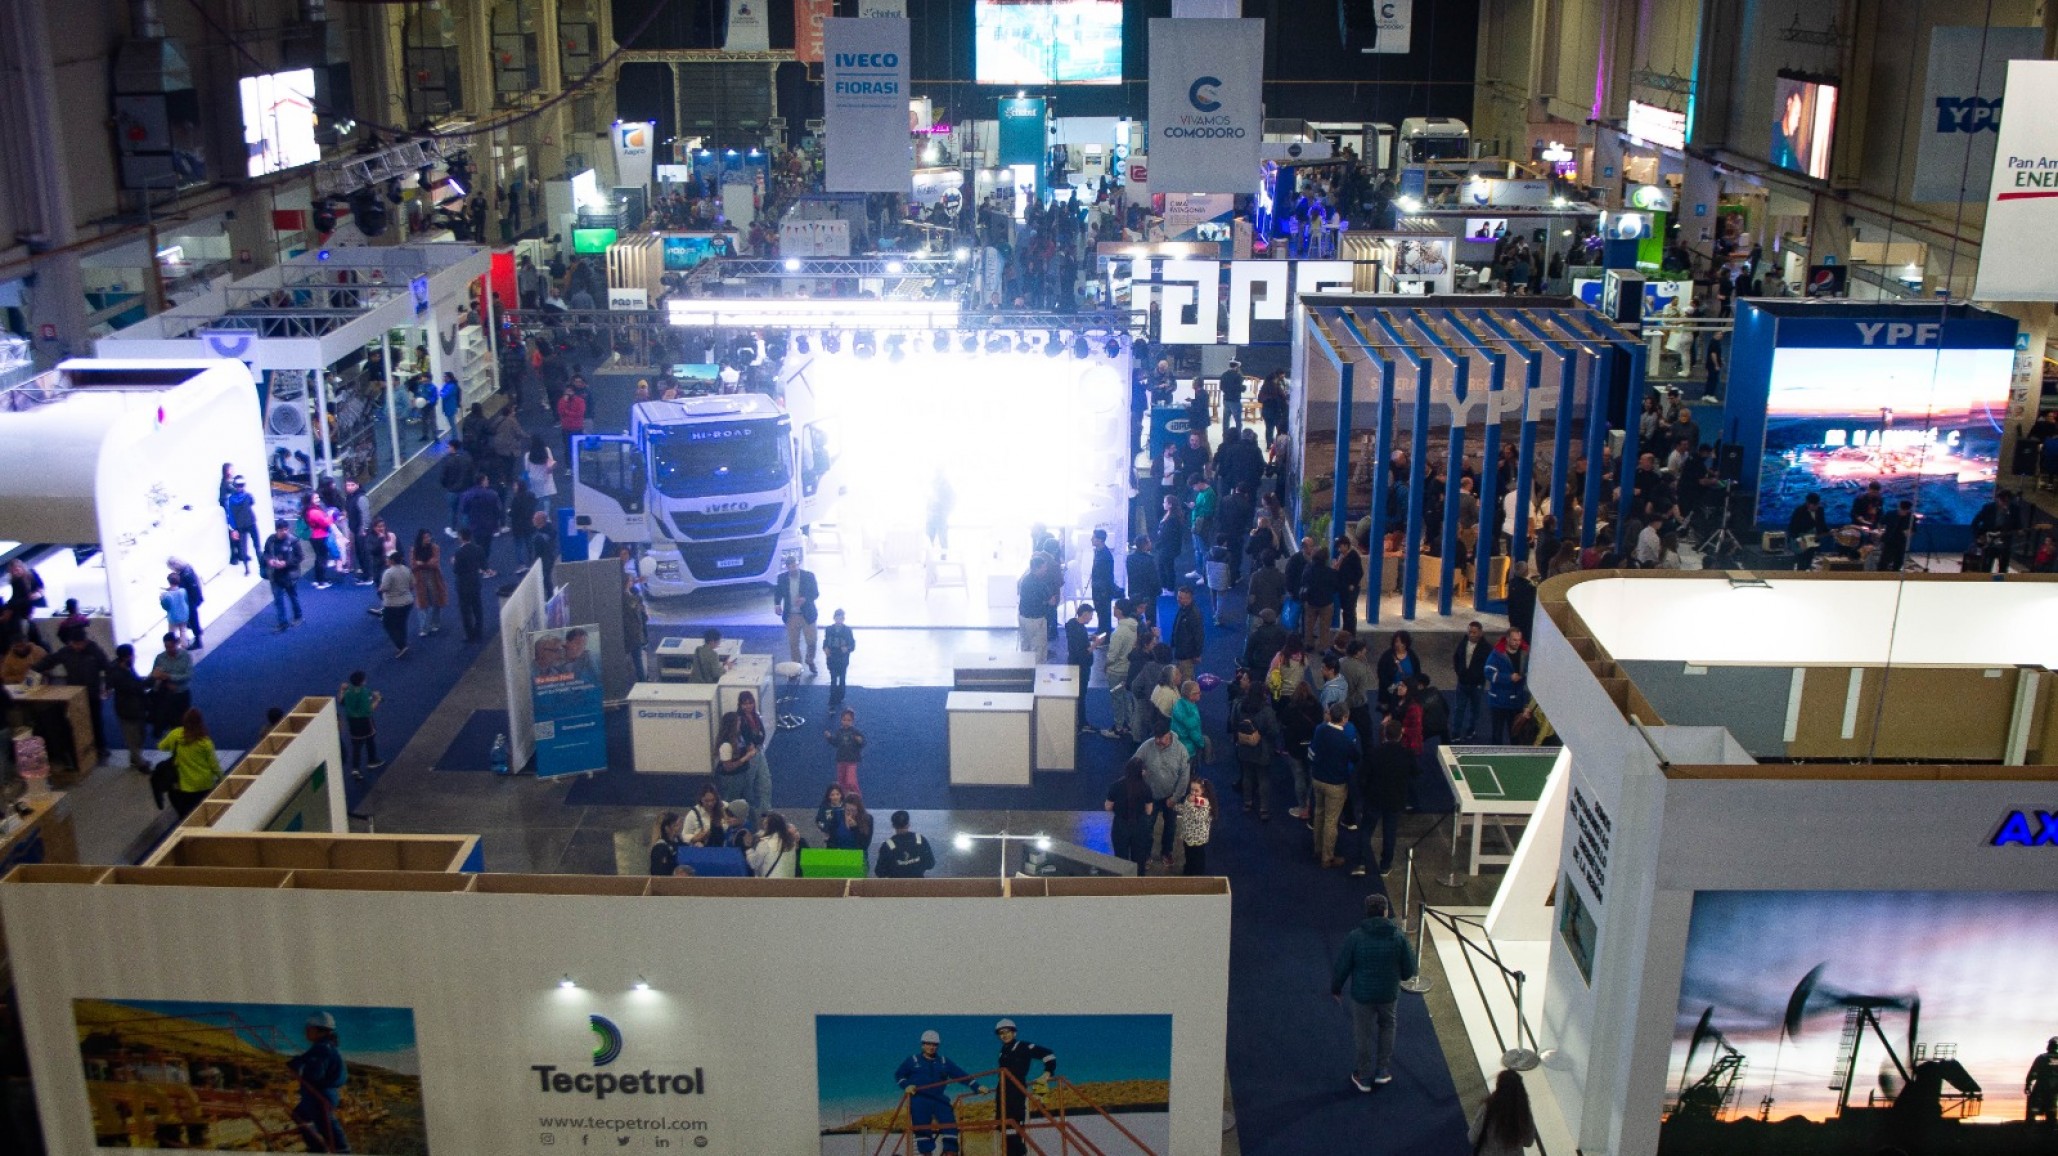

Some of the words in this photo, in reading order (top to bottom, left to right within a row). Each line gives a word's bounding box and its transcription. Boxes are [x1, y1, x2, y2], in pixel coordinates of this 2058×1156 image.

[835, 53, 899, 68] IVECO
[835, 81, 899, 95] FIORASI
[1180, 115, 1231, 126] VIVAMOS
[1163, 126, 1246, 139] COMODORO
[2008, 156, 2034, 168] Pan
[1856, 323, 1940, 346] YPF
[1447, 386, 1560, 428] YPF
[692, 429, 752, 440] HI-ROAD
[705, 502, 749, 513] IVECO
[638, 710, 693, 719] Garantizar
[1990, 810, 2058, 847] AX
[531, 1065, 704, 1100] Tecpetrol
[539, 1117, 708, 1132] www.tecpetrol.com
